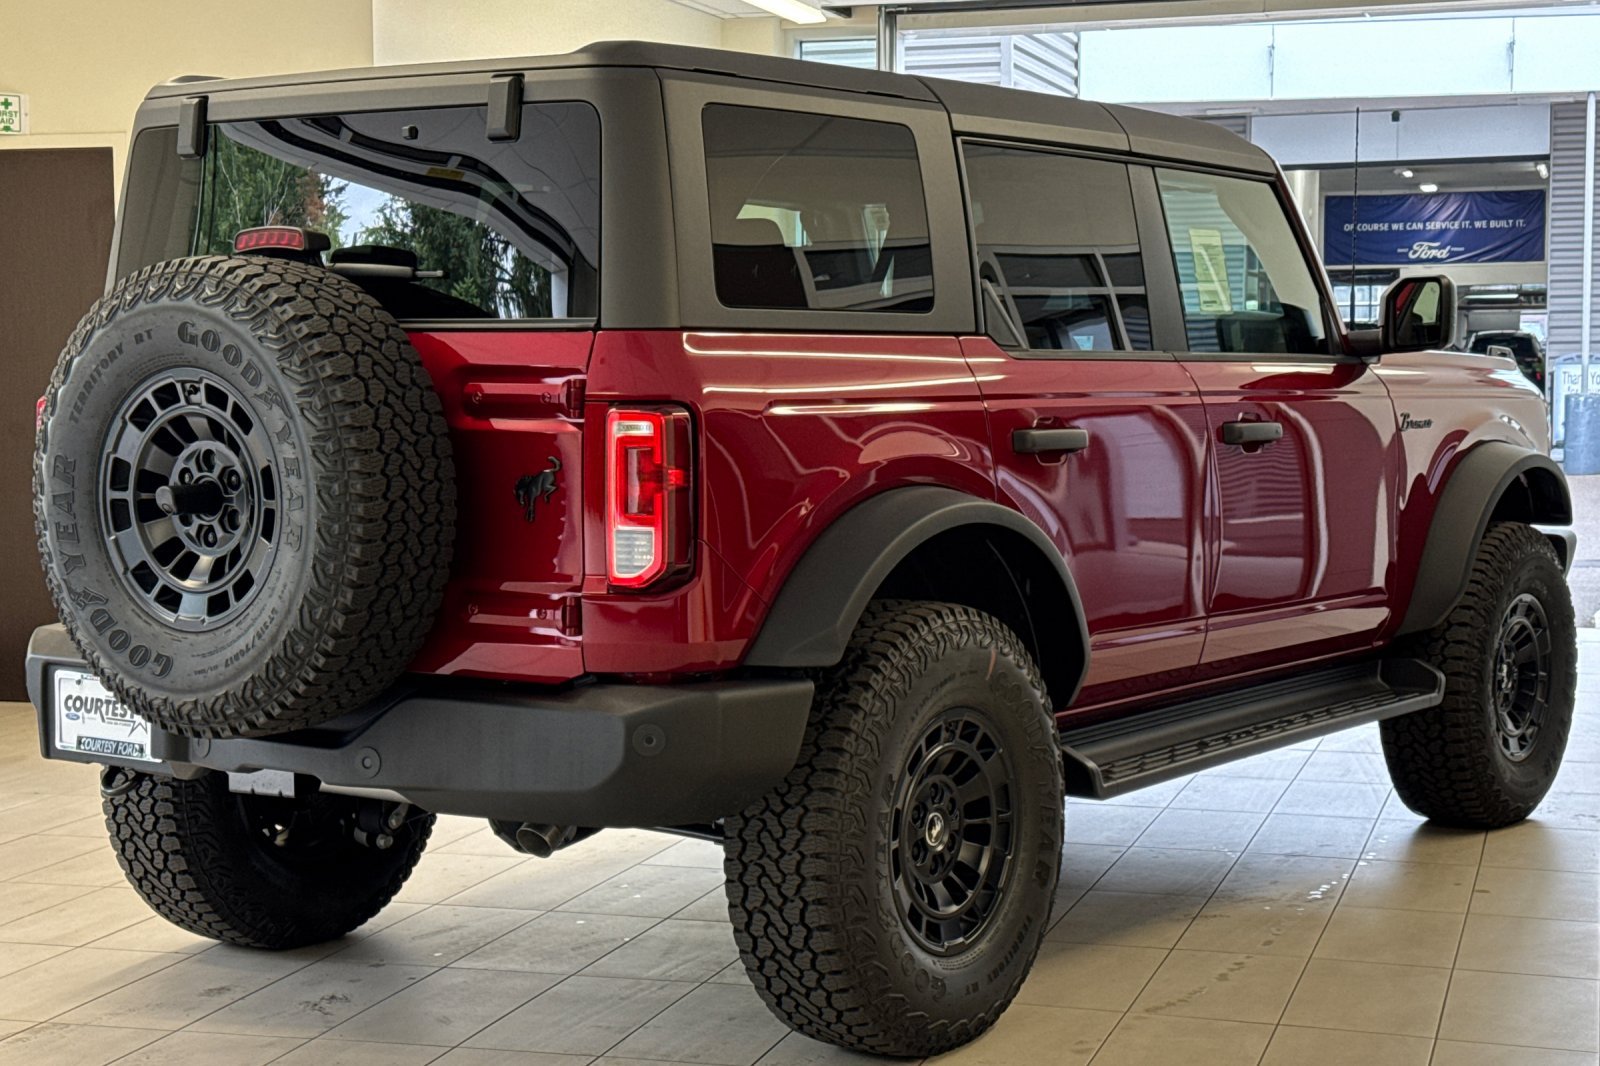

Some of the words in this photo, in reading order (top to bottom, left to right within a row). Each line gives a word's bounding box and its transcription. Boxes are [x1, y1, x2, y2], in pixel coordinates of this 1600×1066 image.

[0, 110, 18, 118] IRST
[1344, 223, 1354, 232] OF
[1356, 223, 1389, 232] COURSE
[1391, 222, 1405, 231] WE
[1406, 221, 1424, 231] CAN
[1425, 220, 1460, 230] SERVICE
[1461, 220, 1472, 229] IT.
[1474, 220, 1488, 229] WE
[1489, 219, 1514, 229] BUILT
[1516, 219, 1527, 228] IT.
[1408, 241, 1451, 259] Ford
[68, 341, 126, 424] TERRITORY
[134, 328, 153, 345] RT
[80, 737, 117, 754] COURTESY
[117, 743, 139, 757] FORD
